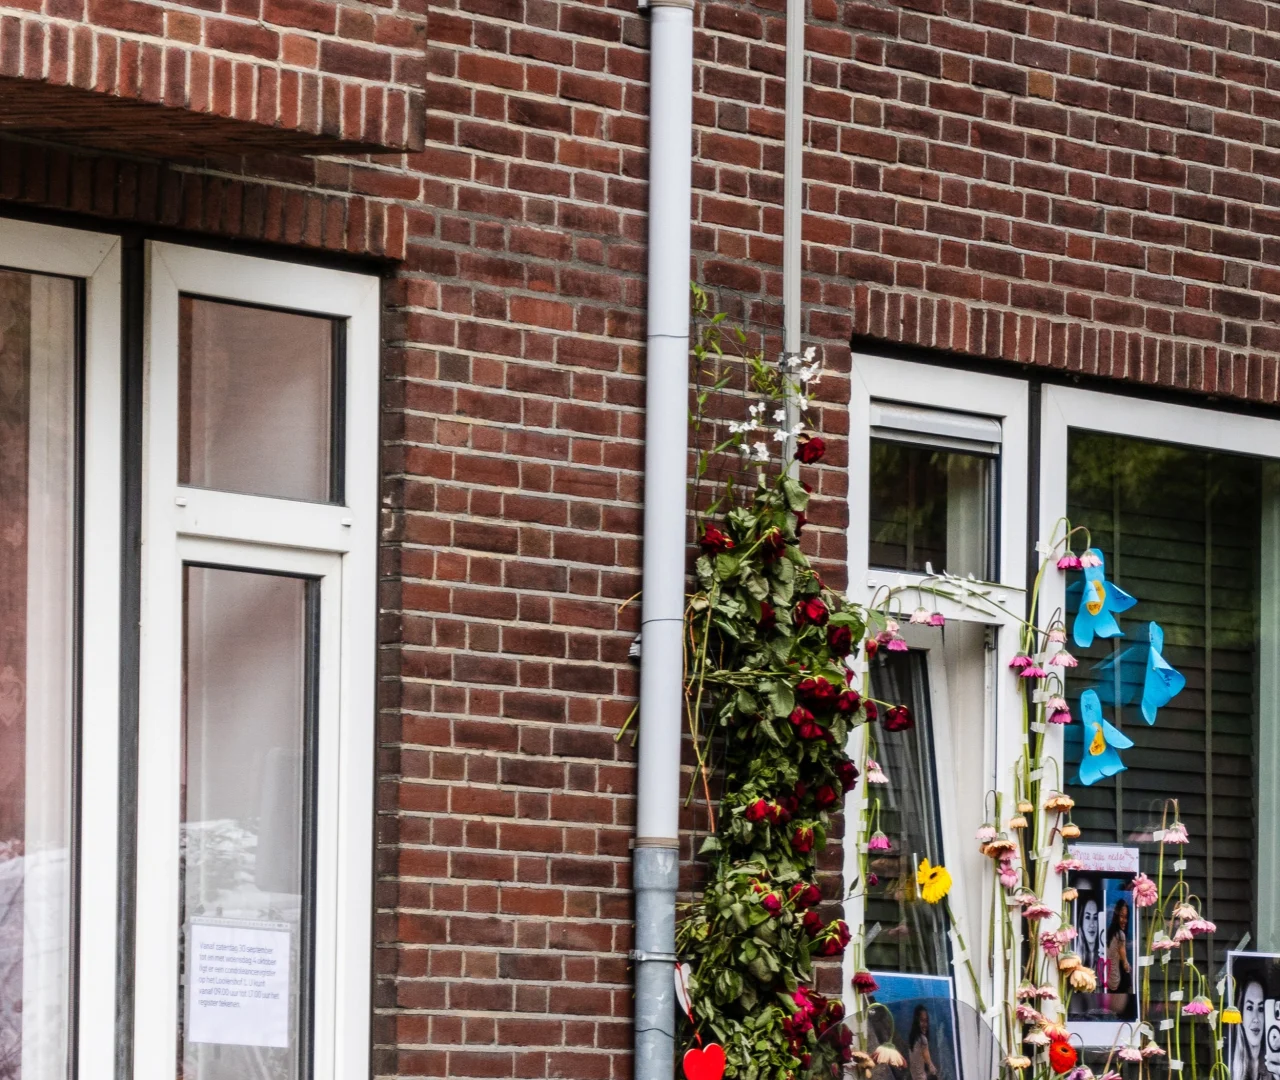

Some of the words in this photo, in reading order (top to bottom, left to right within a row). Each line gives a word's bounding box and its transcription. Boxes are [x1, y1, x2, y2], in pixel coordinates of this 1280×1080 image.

[199, 942, 215, 950] Vanaf
[215, 944, 238, 953] zaterdag
[239, 944, 246, 952] 30
[246, 946, 274, 954] september
[225, 956, 252, 965] woensdag
[257, 958, 277, 966] oktober
[199, 964, 208, 973] ligt
[198, 999, 219, 1007] register
